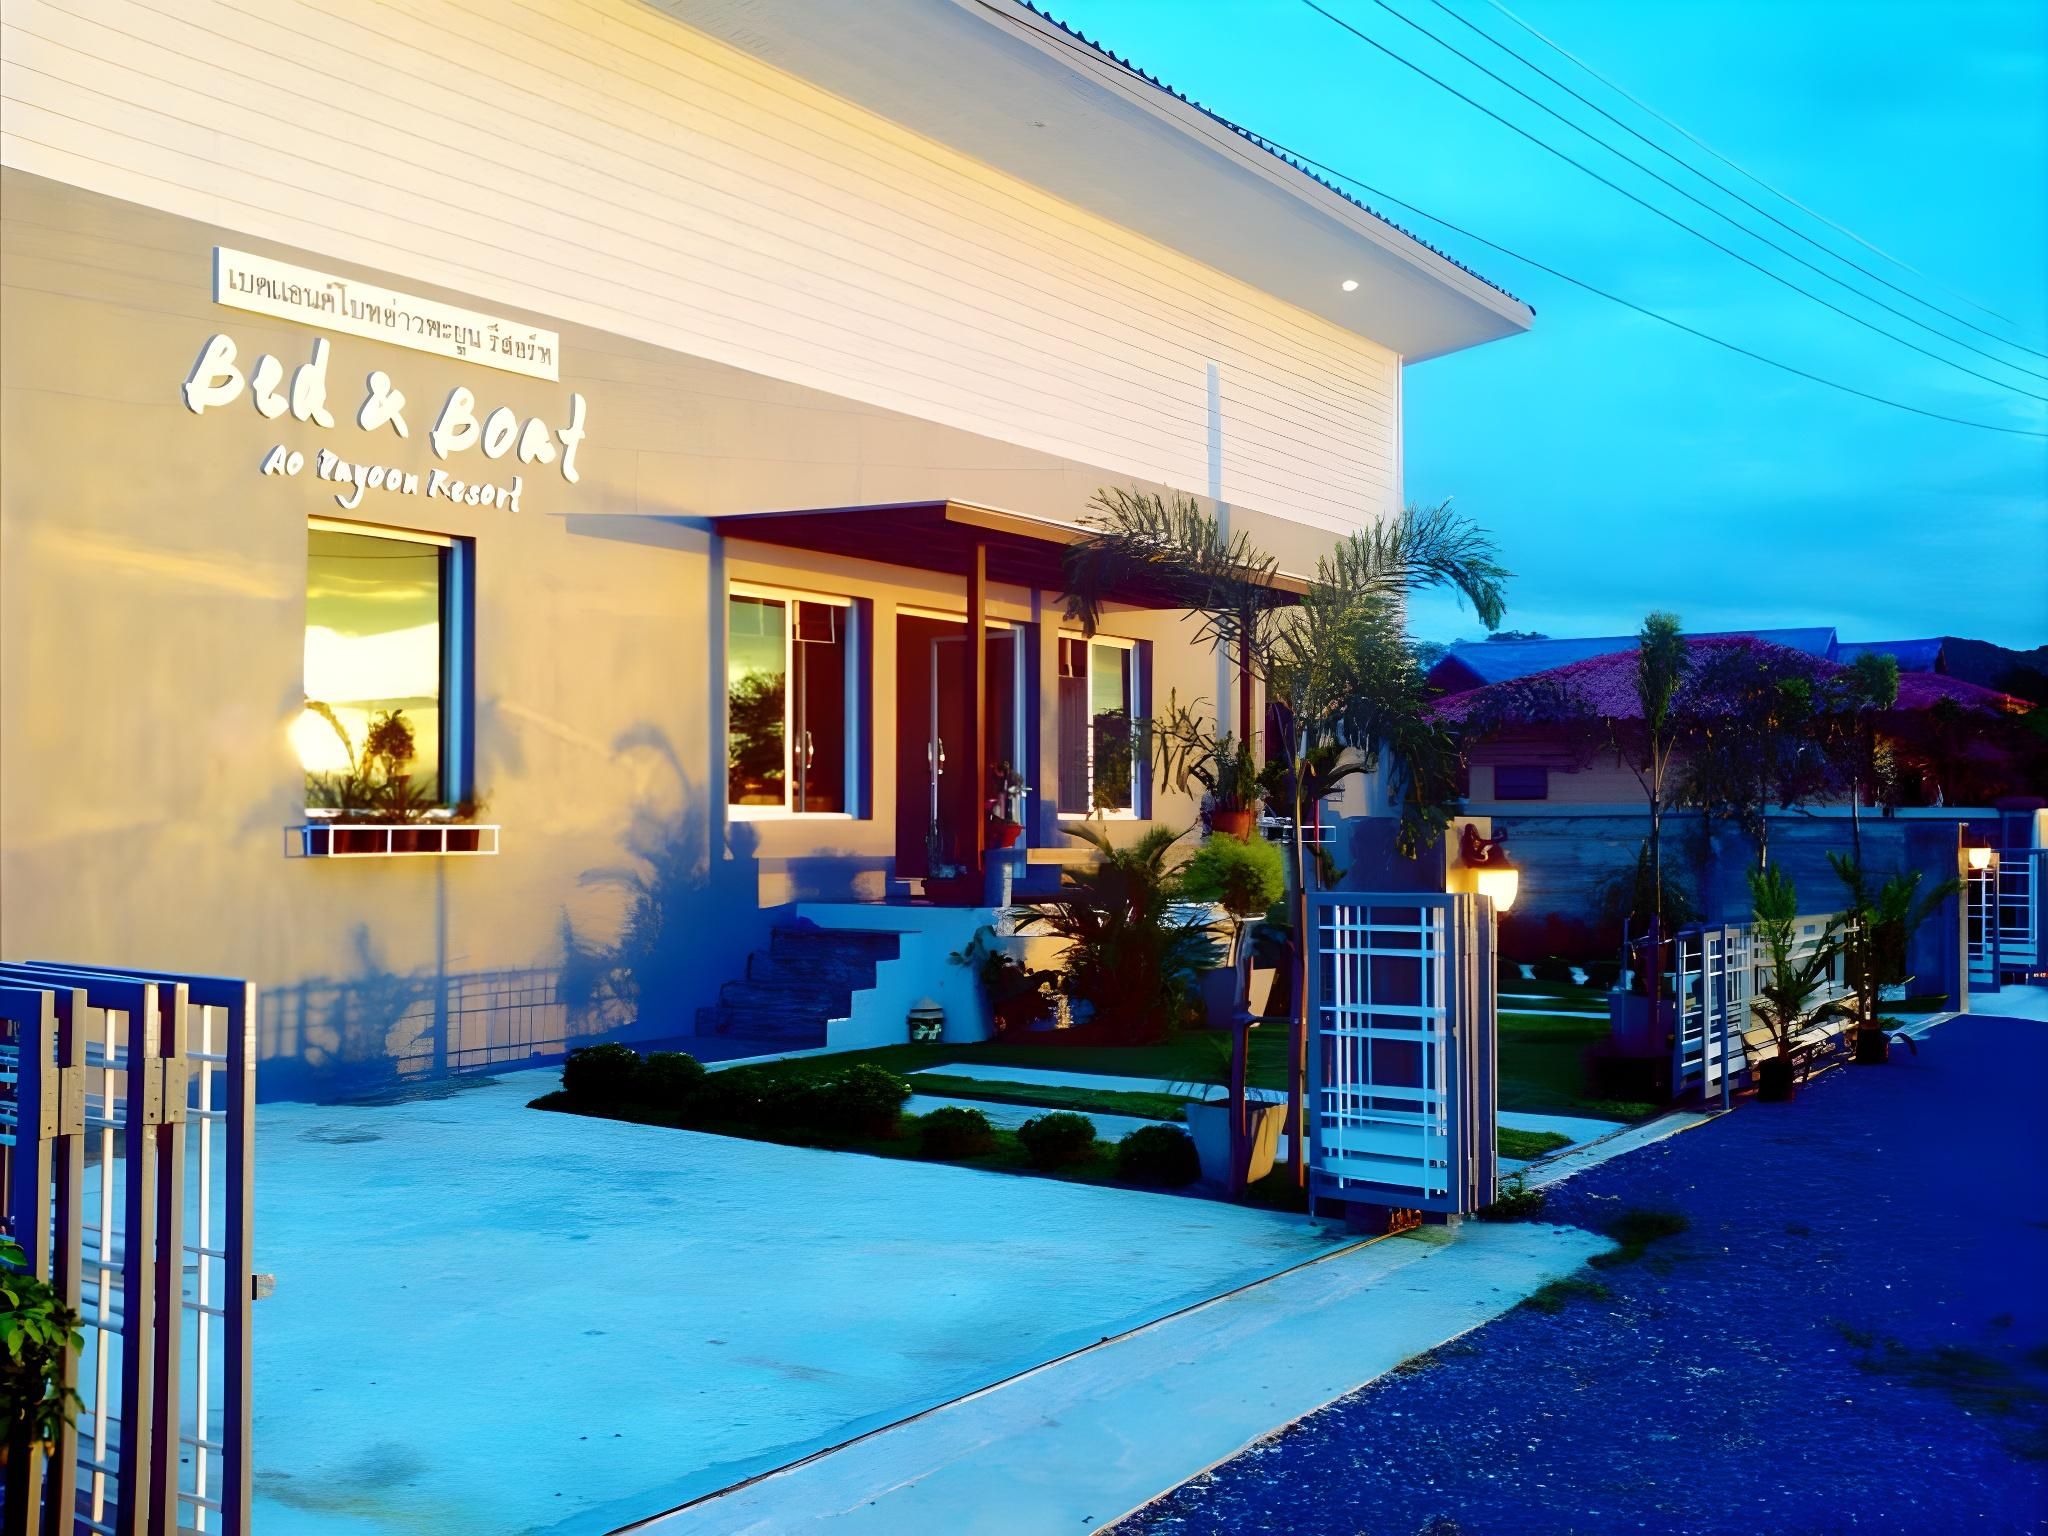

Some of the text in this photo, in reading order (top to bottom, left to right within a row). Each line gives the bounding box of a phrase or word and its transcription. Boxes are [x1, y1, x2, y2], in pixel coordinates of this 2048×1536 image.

[182, 334, 587, 484] Bed & Boat
[260, 445, 305, 476] Ao
[427, 469, 523, 513] Resort
